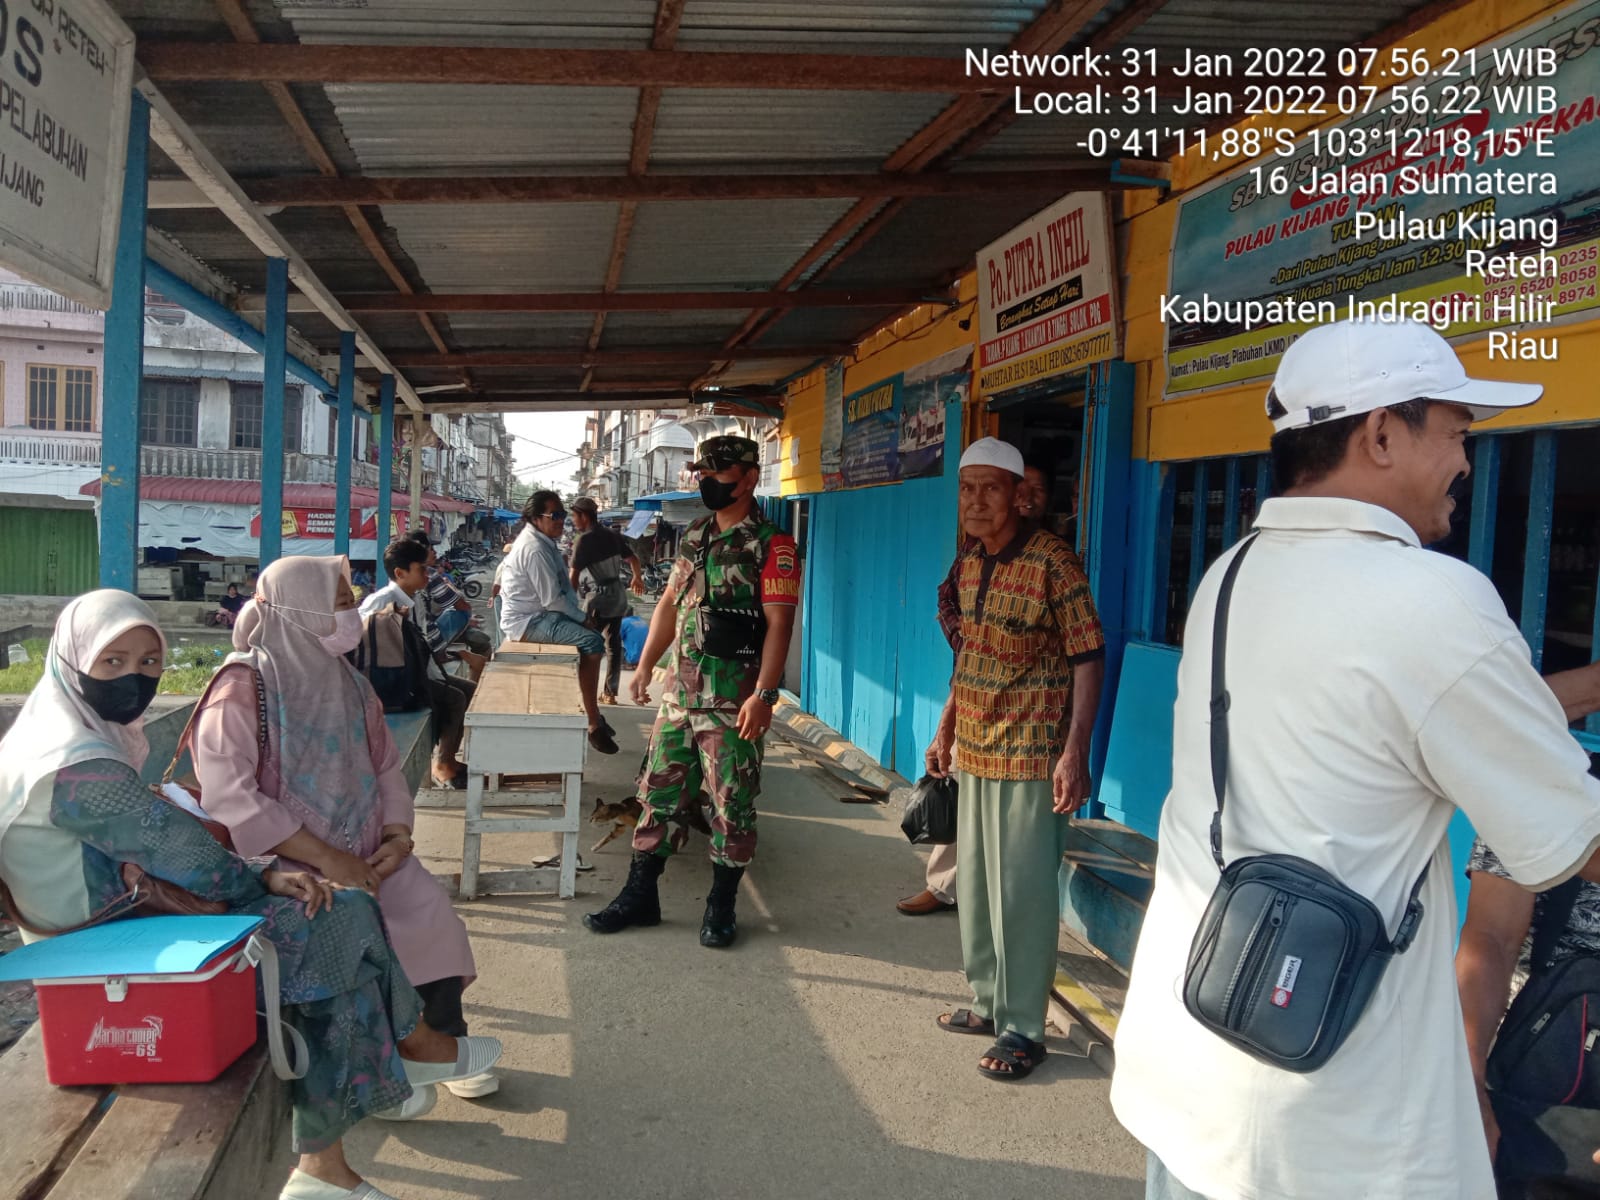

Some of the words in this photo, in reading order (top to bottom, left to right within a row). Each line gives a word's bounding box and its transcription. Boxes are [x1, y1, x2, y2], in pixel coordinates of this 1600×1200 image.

[58, 7, 105, 76] RETEH
[0, 150, 45, 208] IJANG
[1224, 223, 1277, 260] PULAU
[1279, 196, 1351, 239] KIJANG
[1475, 95, 1600, 165] TUNGKA
[1046, 207, 1091, 281] INHIL
[1301, 254, 1336, 274] Pulau
[1336, 237, 1379, 265] Kijang
[1560, 246, 1598, 267] 0235
[1335, 260, 1386, 291] Tungkal
[1386, 256, 1417, 278] Jam
[1418, 239, 1466, 271] 12.30
[1520, 276, 1555, 295] 6520
[1560, 265, 1598, 285] 8058
[1059, 282, 1081, 303] Hari
[1559, 284, 1596, 305] 8974
[1192, 356, 1209, 373] Pulau
[764, 577, 799, 596] BABINS
